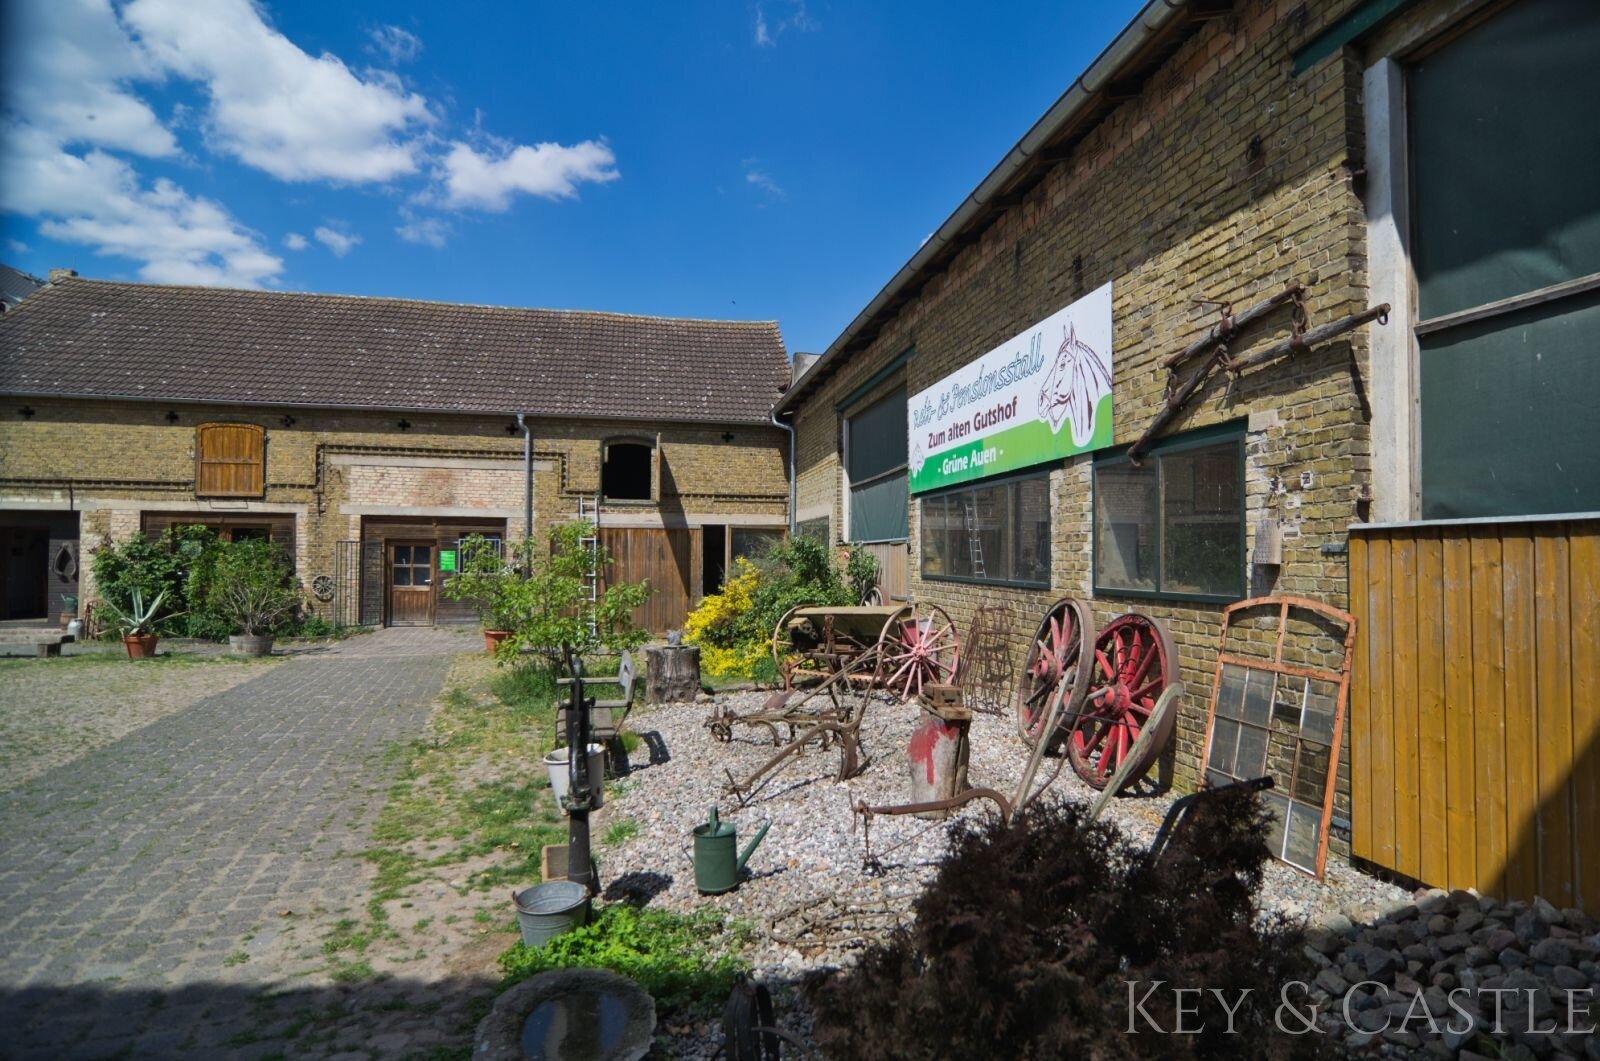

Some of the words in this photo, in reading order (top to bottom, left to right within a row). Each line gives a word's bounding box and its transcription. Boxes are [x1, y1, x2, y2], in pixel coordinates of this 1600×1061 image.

[938, 391, 950, 421] &
[950, 332, 1045, 413] Pensionsstall
[928, 430, 946, 449] Zum
[948, 420, 970, 442] alten
[974, 396, 1018, 431] Gutshof
[942, 454, 968, 475] Grüne
[970, 447, 996, 468] Auen
